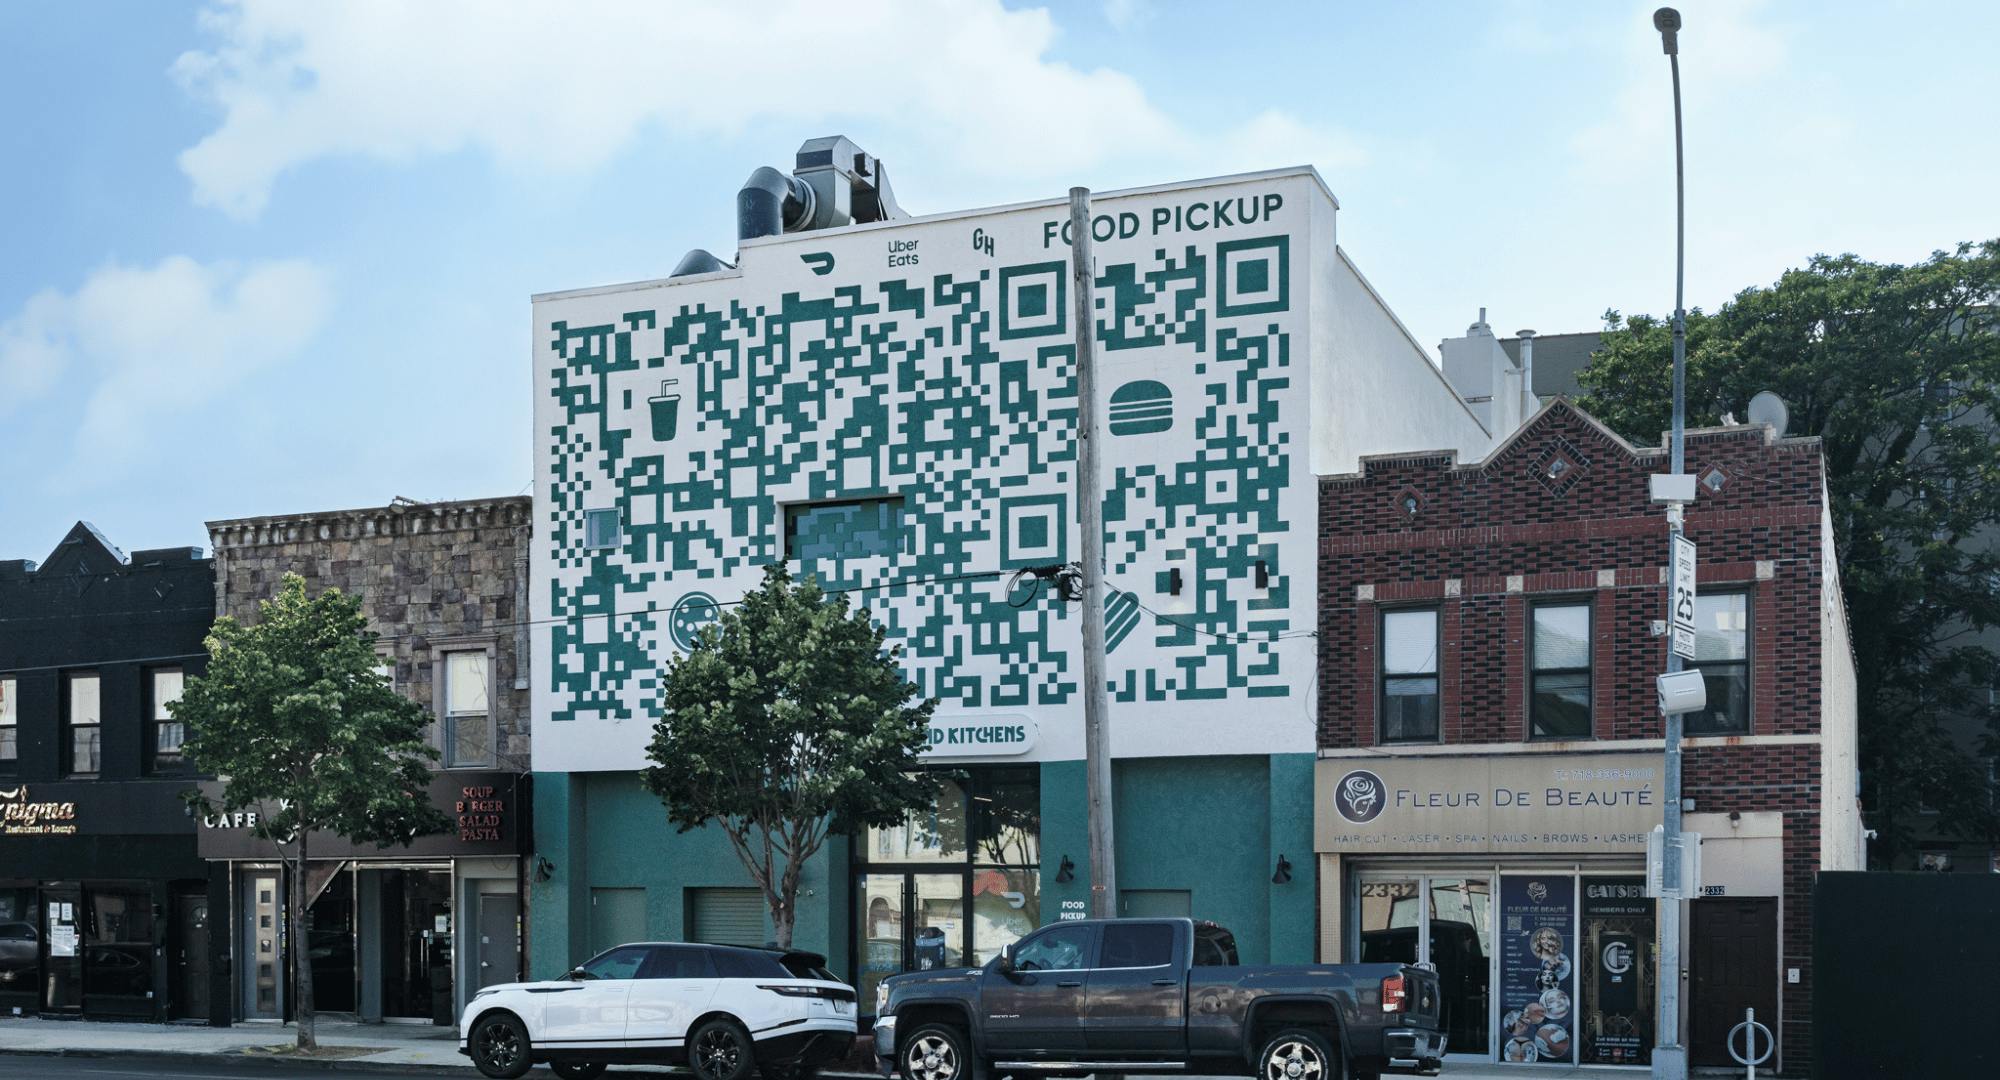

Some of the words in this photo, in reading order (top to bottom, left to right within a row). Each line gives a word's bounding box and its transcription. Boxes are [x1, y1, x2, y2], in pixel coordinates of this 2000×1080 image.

[1152, 193, 1283, 236] PICKUP
[888, 240, 919, 254] Uber
[973, 227, 994, 258] GH
[888, 254, 919, 268] Eats
[1677, 586, 1693, 621] 25
[948, 726, 1025, 744] KITCHENS
[462, 786, 493, 798] SOUP
[204, 813, 256, 828] CAFE
[459, 815, 500, 827] SALAD
[462, 829, 499, 841] PASTA
[1334, 834, 1360, 843] HAIR
[1455, 834, 1477, 843] SPA
[1493, 834, 1528, 843] NAILS
[1543, 834, 1589, 843] BROWS
[1603, 834, 1647, 843] LASHE
[1062, 901, 1085, 910] FOOD
[1060, 912, 1086, 920] PICKUP
